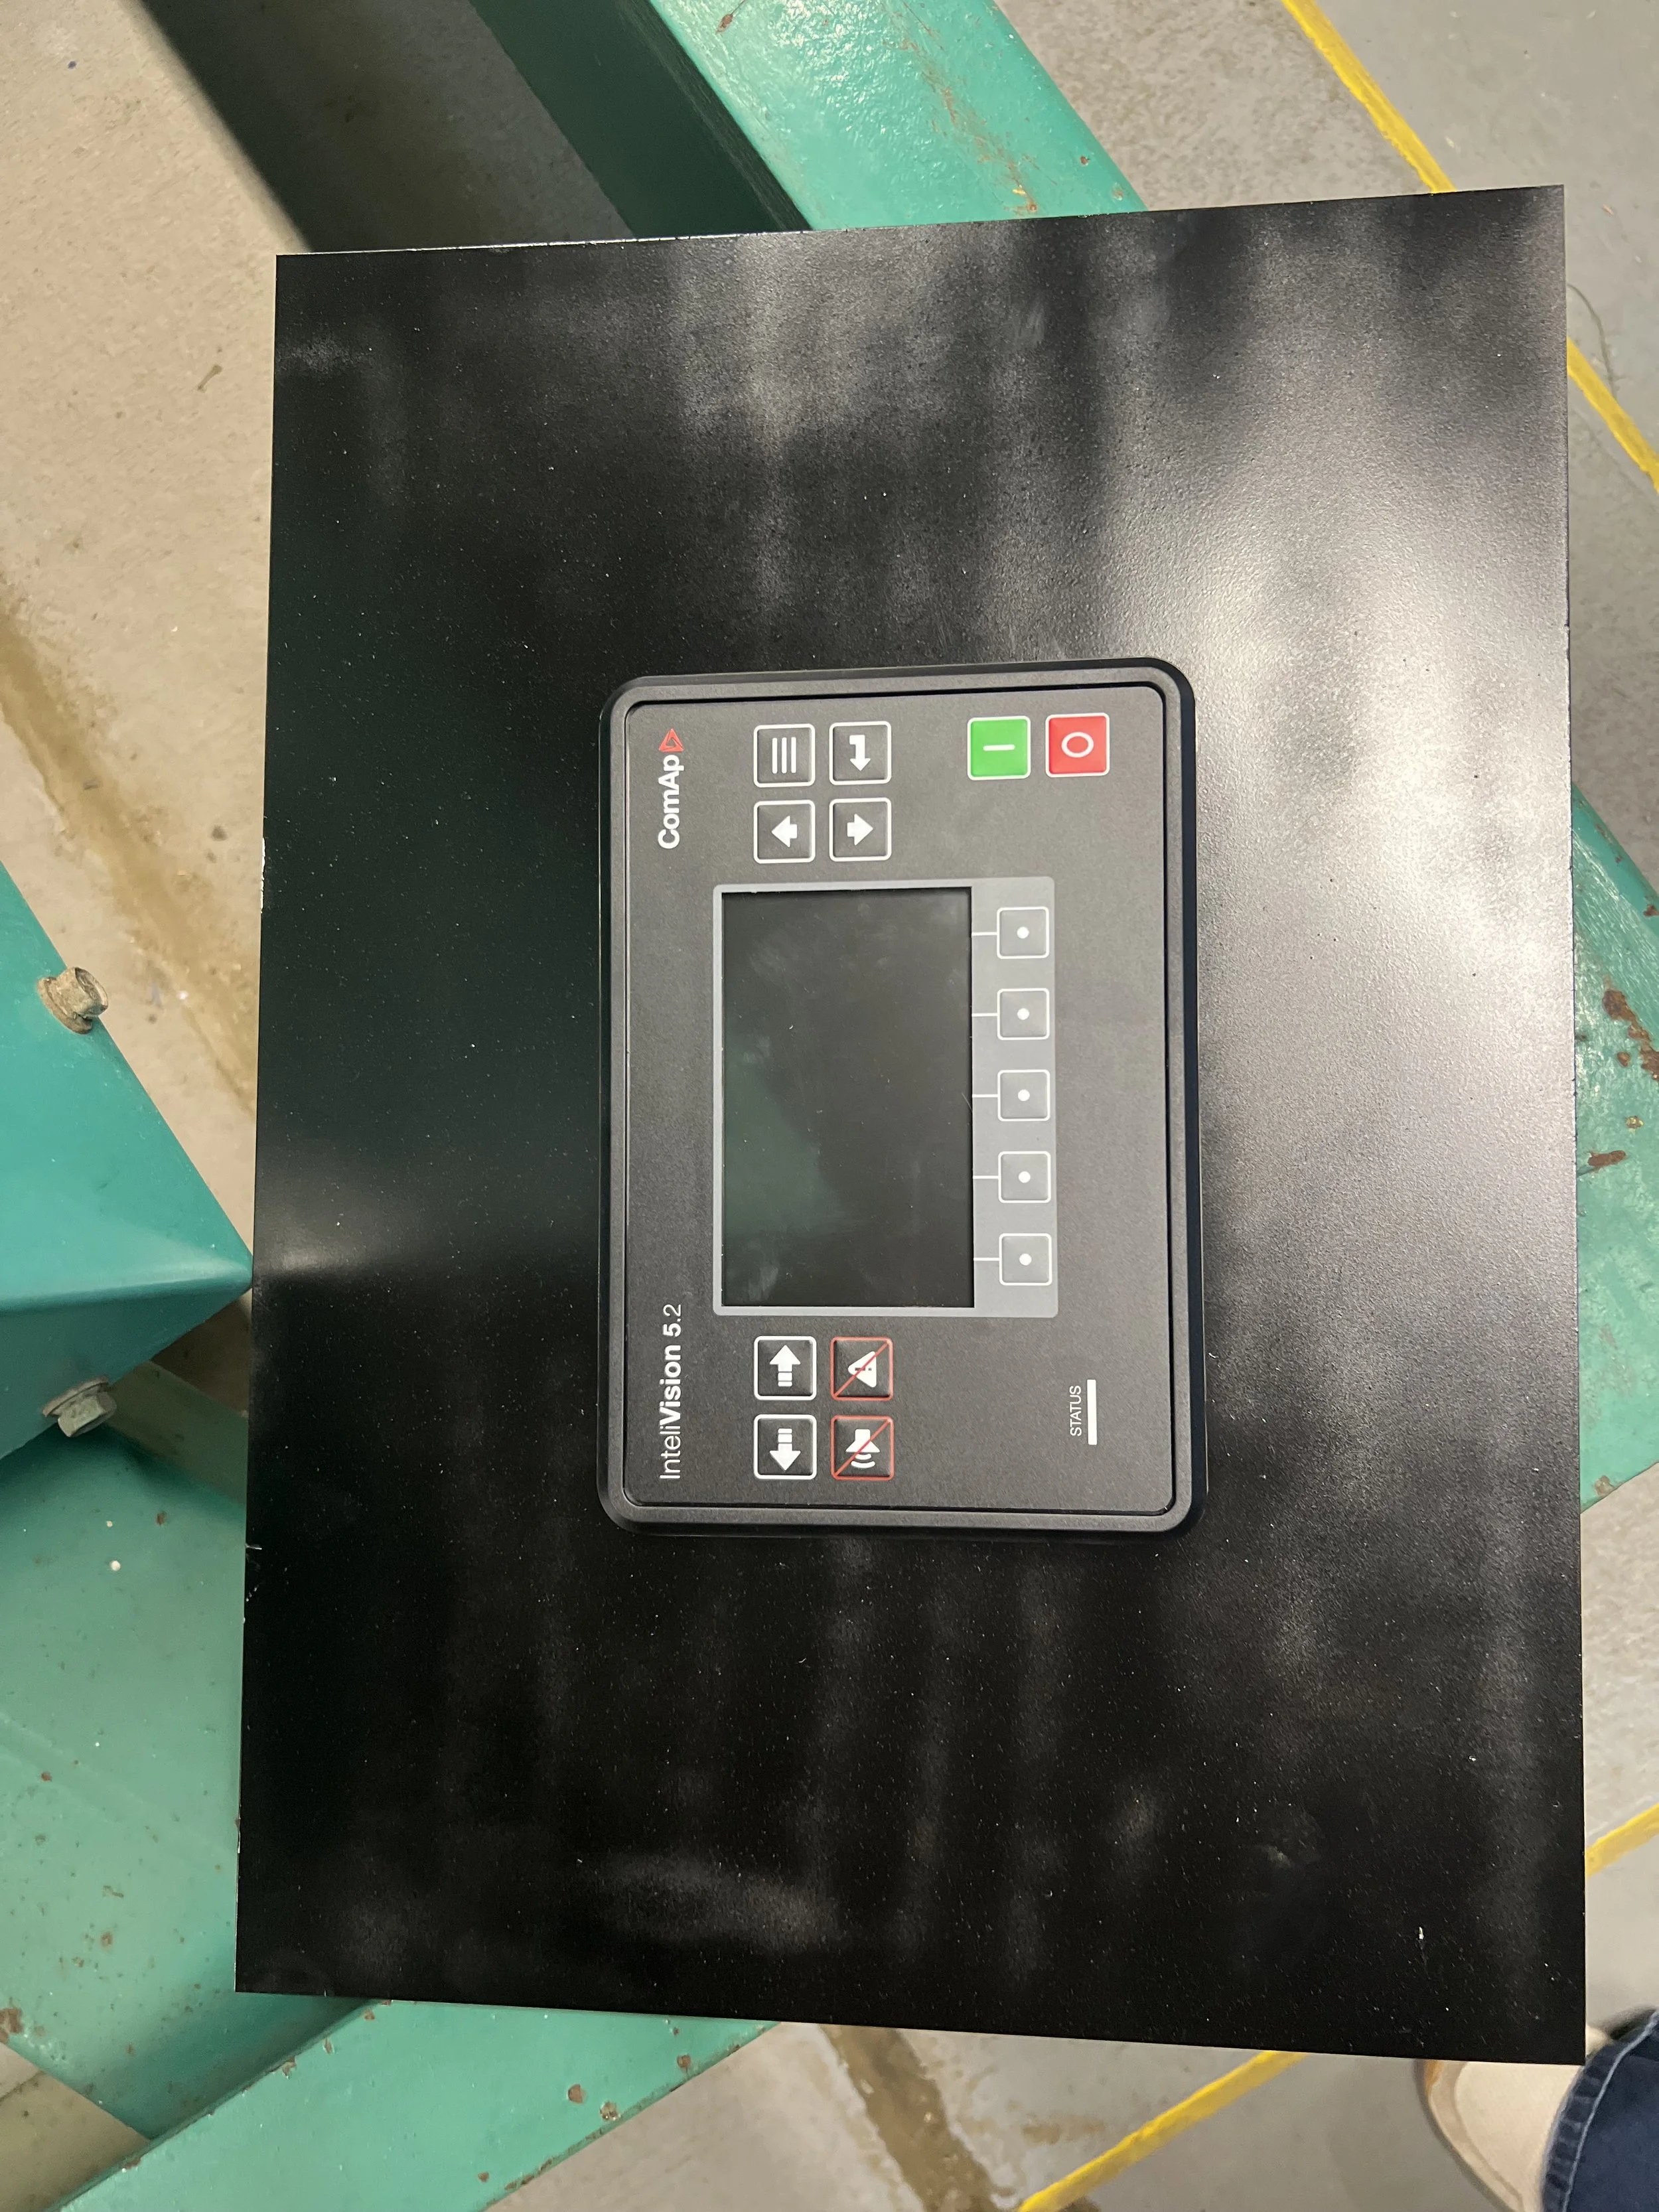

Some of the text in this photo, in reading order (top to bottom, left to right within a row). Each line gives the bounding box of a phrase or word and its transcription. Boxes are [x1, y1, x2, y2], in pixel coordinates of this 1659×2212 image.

[658, 754, 685, 849] ComAp
[659, 1303, 682, 1479] InteliVision 5.2
[1069, 1385, 1082, 1437] STATUS
